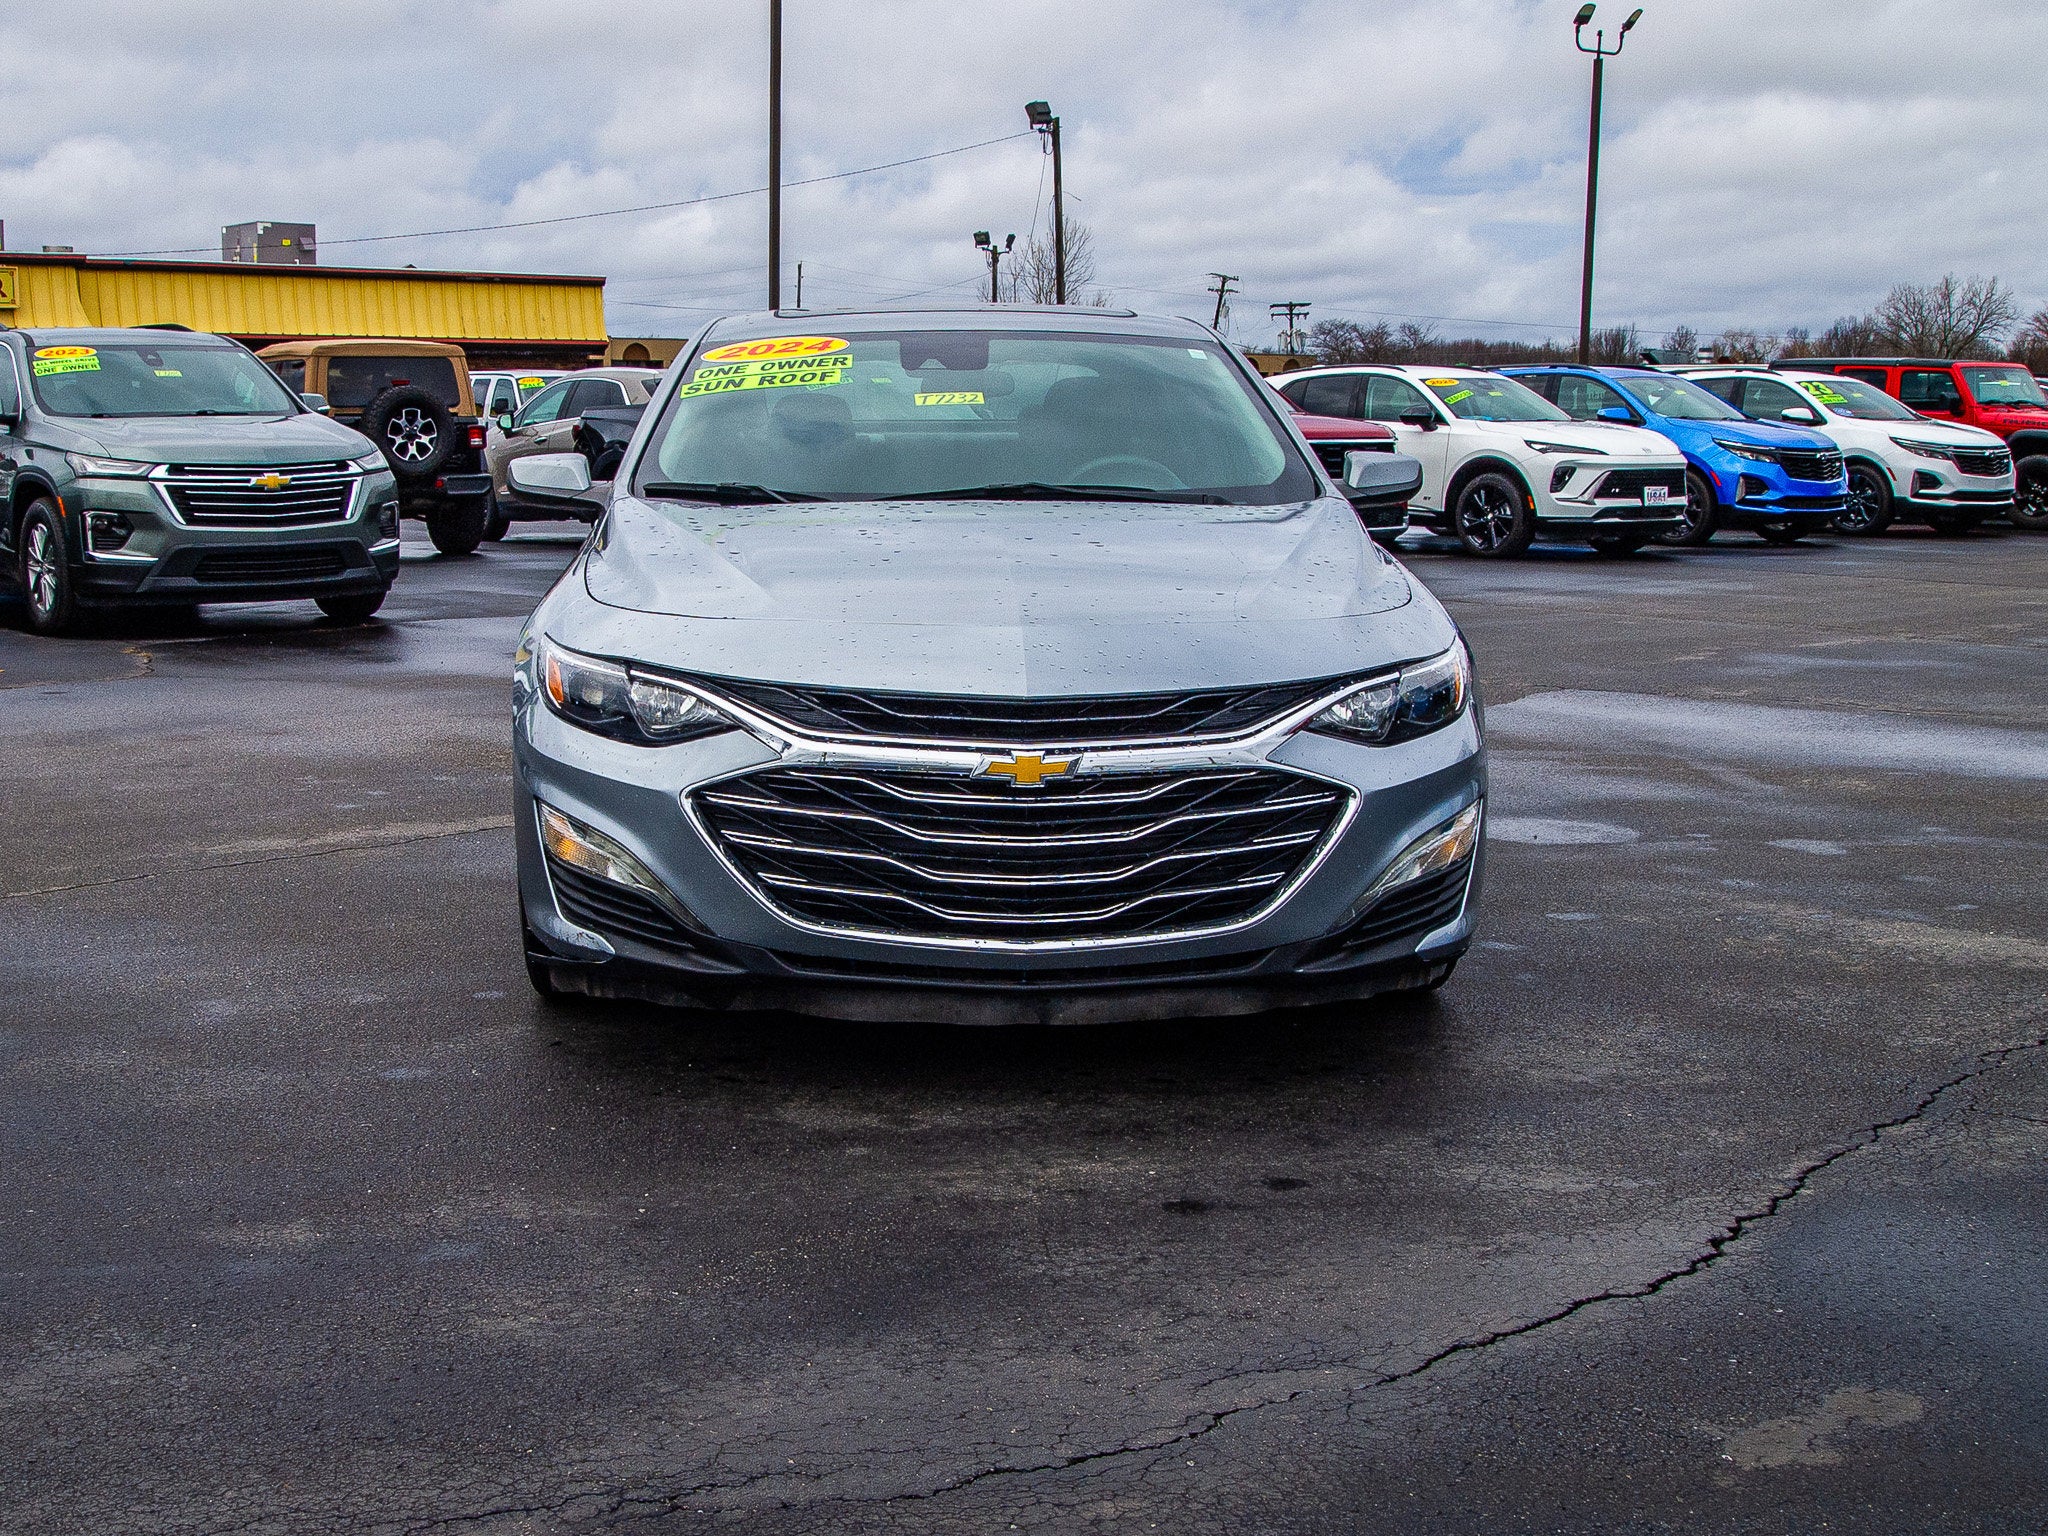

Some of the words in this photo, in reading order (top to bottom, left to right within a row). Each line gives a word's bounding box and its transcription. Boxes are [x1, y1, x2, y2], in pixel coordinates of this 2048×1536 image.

[43, 348, 90, 358] 2023
[715, 340, 835, 360] 2024
[36, 367, 57, 375] ONE
[61, 363, 98, 372] OWNER
[698, 364, 749, 379] ONE
[760, 356, 848, 372] OWNER
[684, 377, 745, 396] SUN
[758, 370, 836, 387] ROOF
[1799, 381, 1834, 396] 23
[917, 393, 981, 405] T7232
